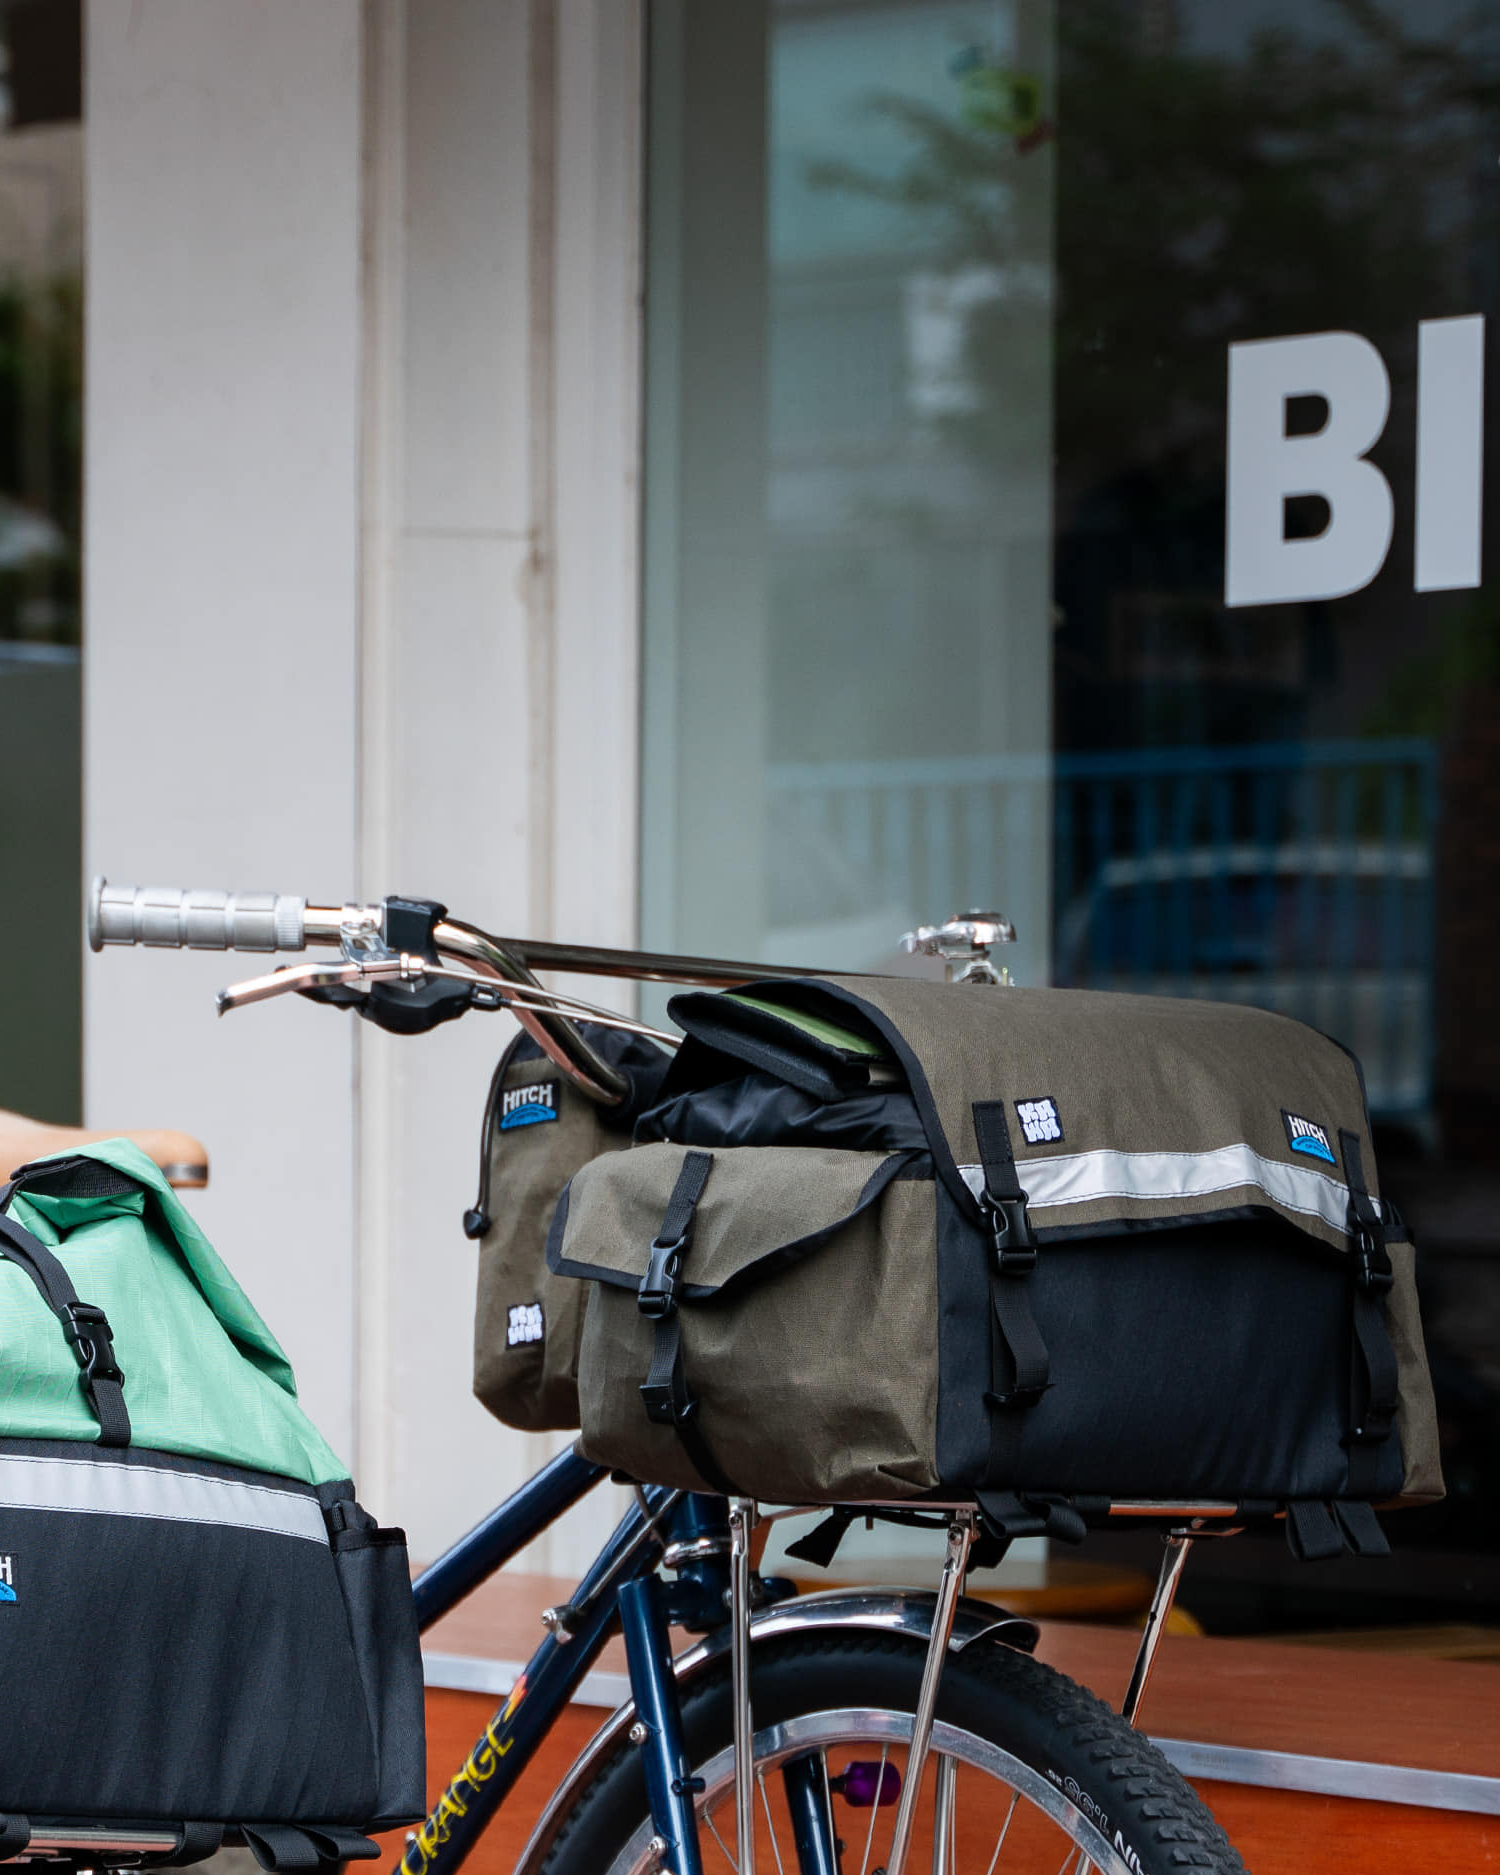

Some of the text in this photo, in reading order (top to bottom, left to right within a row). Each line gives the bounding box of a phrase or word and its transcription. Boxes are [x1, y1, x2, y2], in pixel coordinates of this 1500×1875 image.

[1224, 313, 1485, 608] BI
[503, 1084, 553, 1116] HITCH
[1288, 1115, 1330, 1150] HITCH
